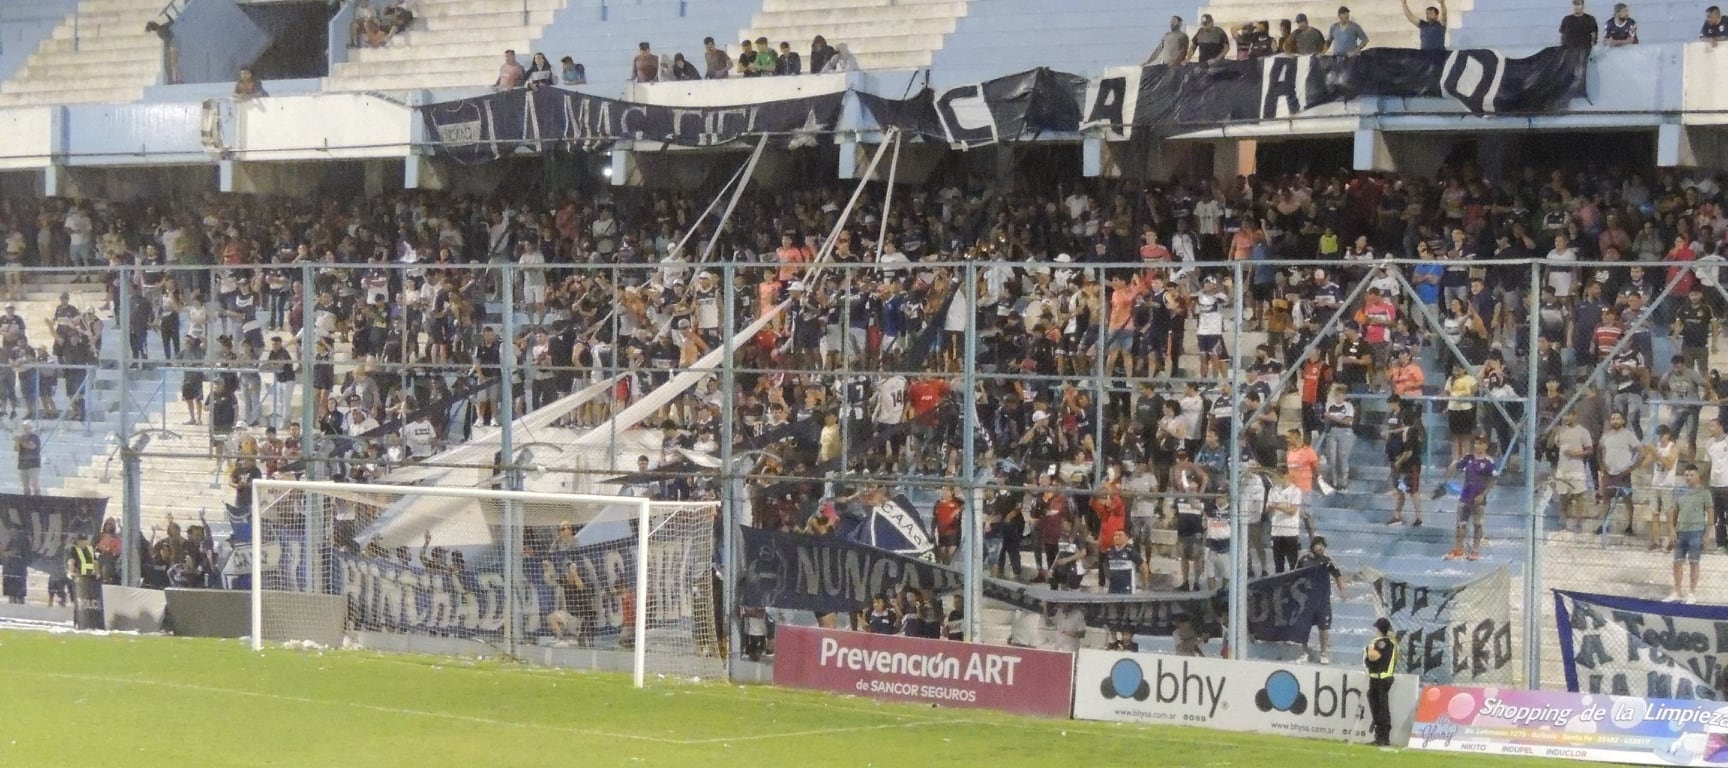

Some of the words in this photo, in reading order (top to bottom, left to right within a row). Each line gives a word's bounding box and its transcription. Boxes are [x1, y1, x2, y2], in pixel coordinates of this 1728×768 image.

[891, 389, 903, 408] 14
[820, 637, 960, 682] Prevención
[963, 652, 1022, 686] ART
[856, 679, 869, 691] de
[870, 681, 918, 697] SANCOR
[920, 685, 976, 703] SEGUROS
[1157, 658, 1226, 719] bhy
[1479, 697, 1573, 726] Shopping
[1579, 702, 1606, 721] de
[1614, 703, 1634, 721] la
[1643, 702, 1728, 733] Limpieza
[1461, 743, 1487, 752] NIKITO
[1501, 745, 1534, 754] INDUPEL
[1545, 748, 1588, 758] INDUCLOR
